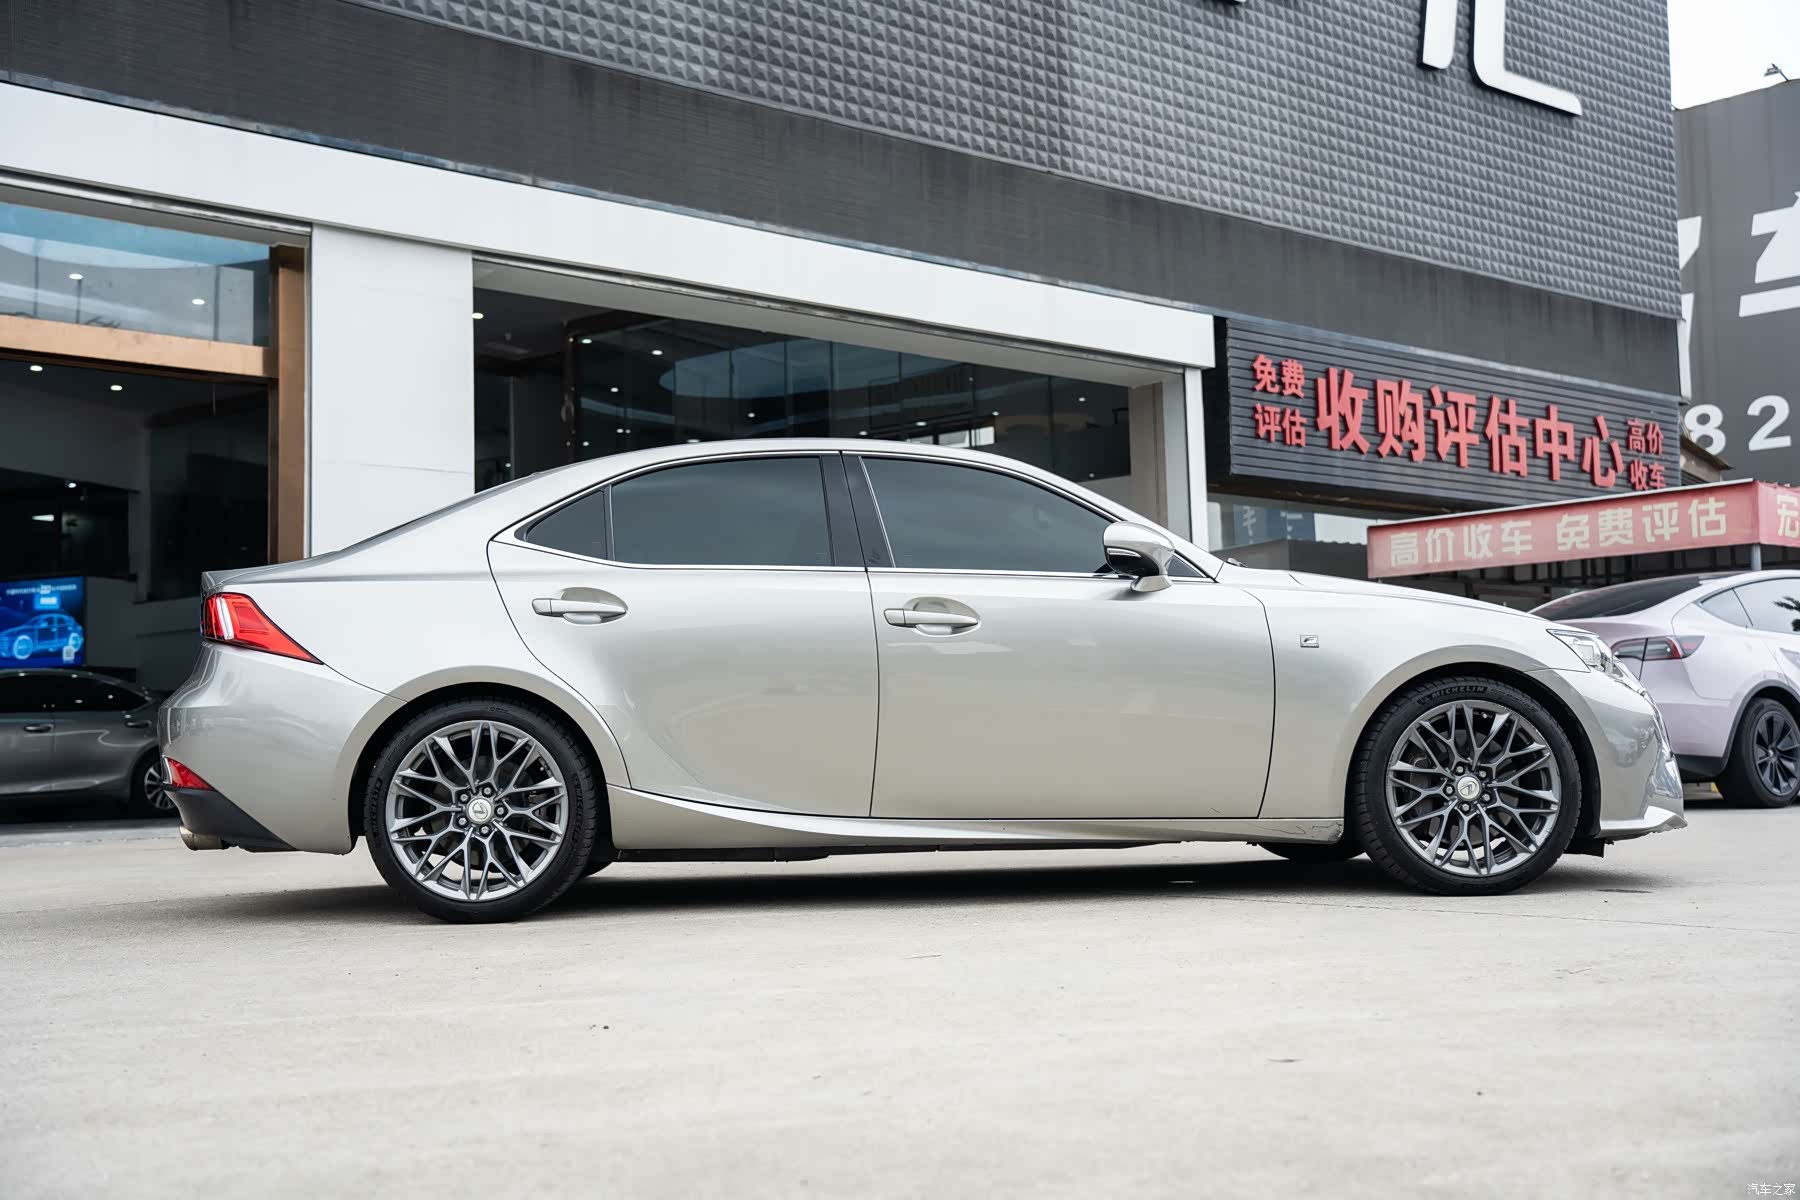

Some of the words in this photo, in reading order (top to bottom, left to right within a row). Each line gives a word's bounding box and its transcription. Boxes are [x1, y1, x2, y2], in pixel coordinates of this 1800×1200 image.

[1253, 353, 1305, 398] 免费
[1254, 403, 1307, 447] 评估
[1317, 368, 1625, 487] 收购评估中心
[1627, 418, 1665, 456] 高价
[1630, 459, 1666, 491] 收车
[1390, 519, 1533, 567] 高价收车
[1556, 497, 1727, 550] 免费评估
[1431, 685, 1486, 699] MICHELIN
